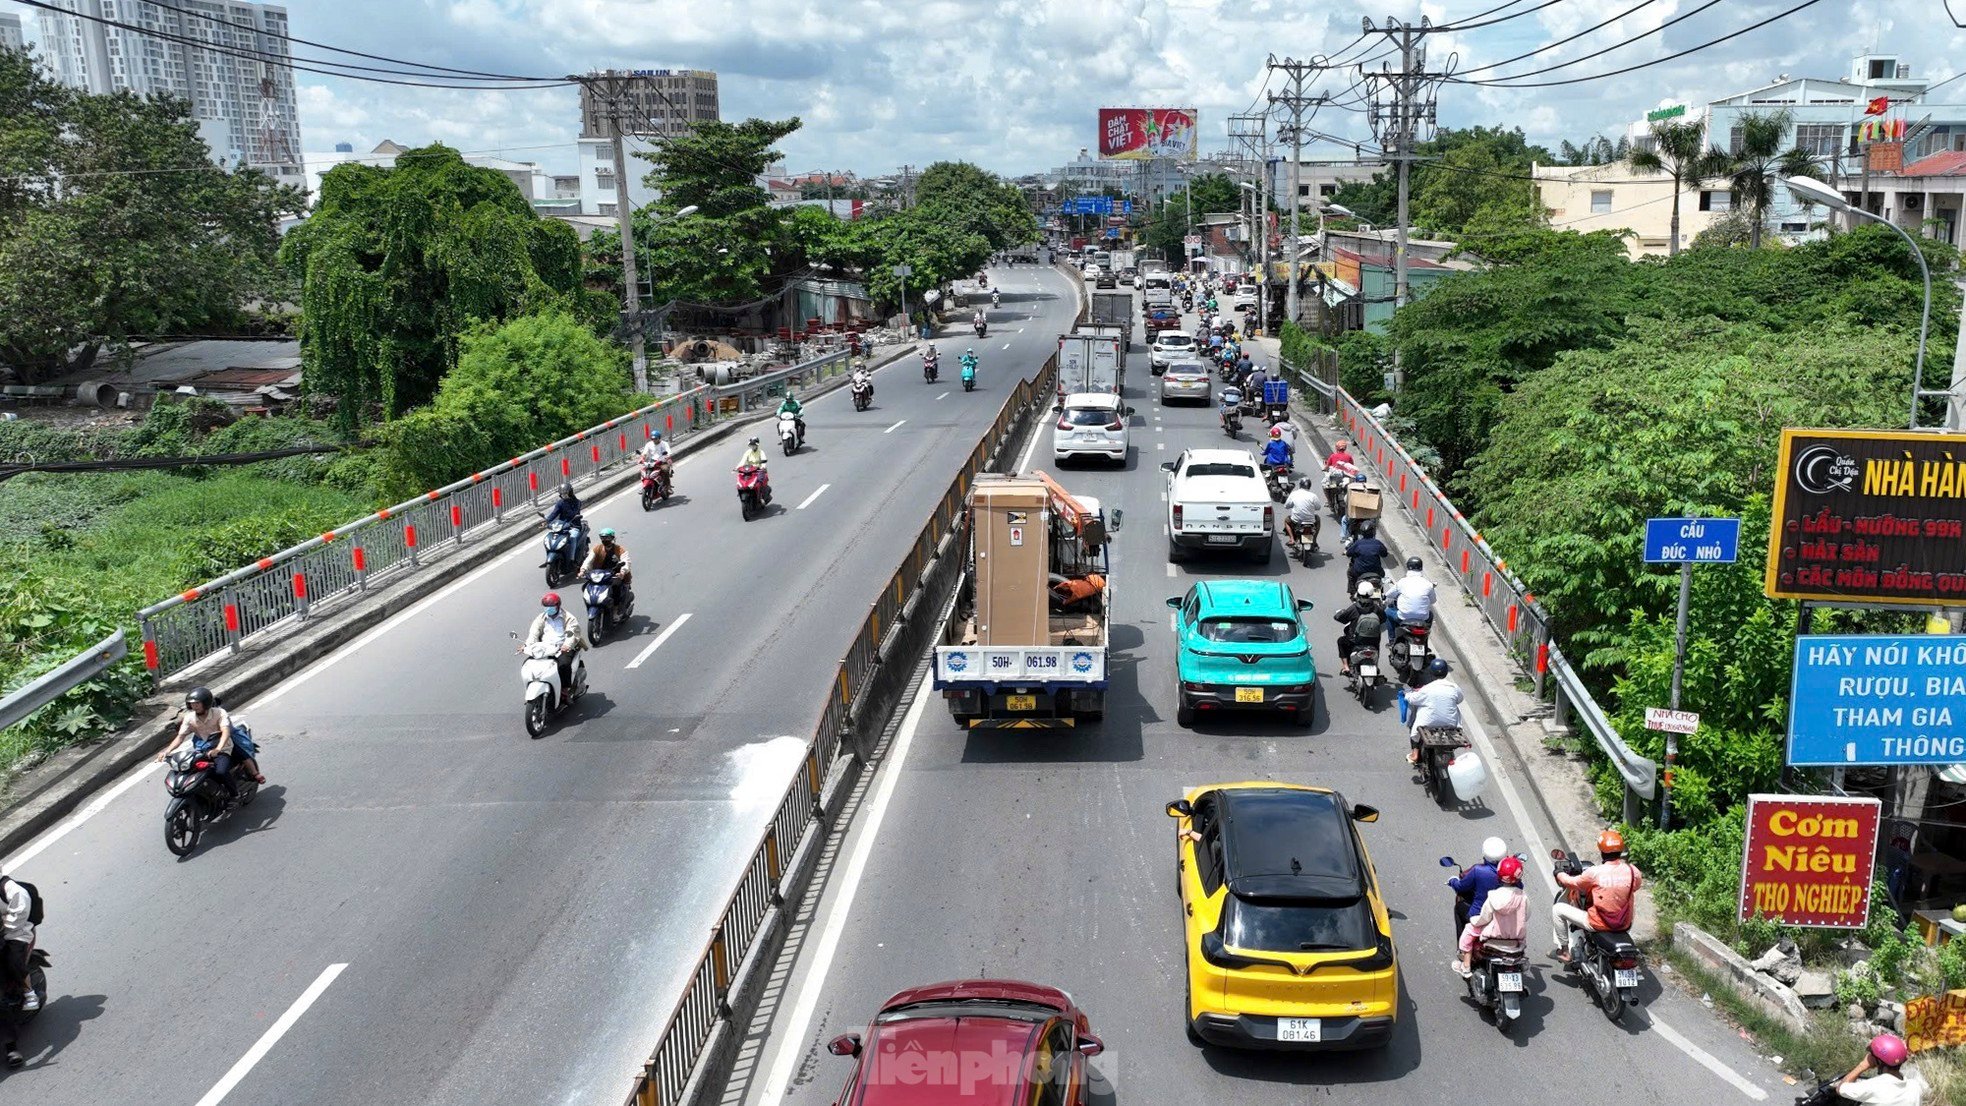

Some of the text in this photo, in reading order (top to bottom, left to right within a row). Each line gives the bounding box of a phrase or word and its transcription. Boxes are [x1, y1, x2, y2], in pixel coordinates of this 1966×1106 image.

[1863, 450, 1915, 497] NHÀ
[1680, 520, 1705, 539] CẦU
[1661, 541, 1722, 560] ĐÚC NHỎ
[1026, 656, 1057, 668] 061.98
[1808, 643, 1857, 667] HÃY
[1865, 642, 1909, 667] NÓI
[1926, 676, 1966, 697] BIA
[1833, 707, 1953, 728] THAM GIA
[1881, 734, 1966, 757] THÔNG
[1769, 809, 1859, 838] Cơm
[1763, 844, 1857, 873] Niêu
[1793, 876, 1863, 922] NGHIỆP
[1290, 1019, 1308, 1030] 61K
[1282, 1030, 1316, 1041] 081.46
